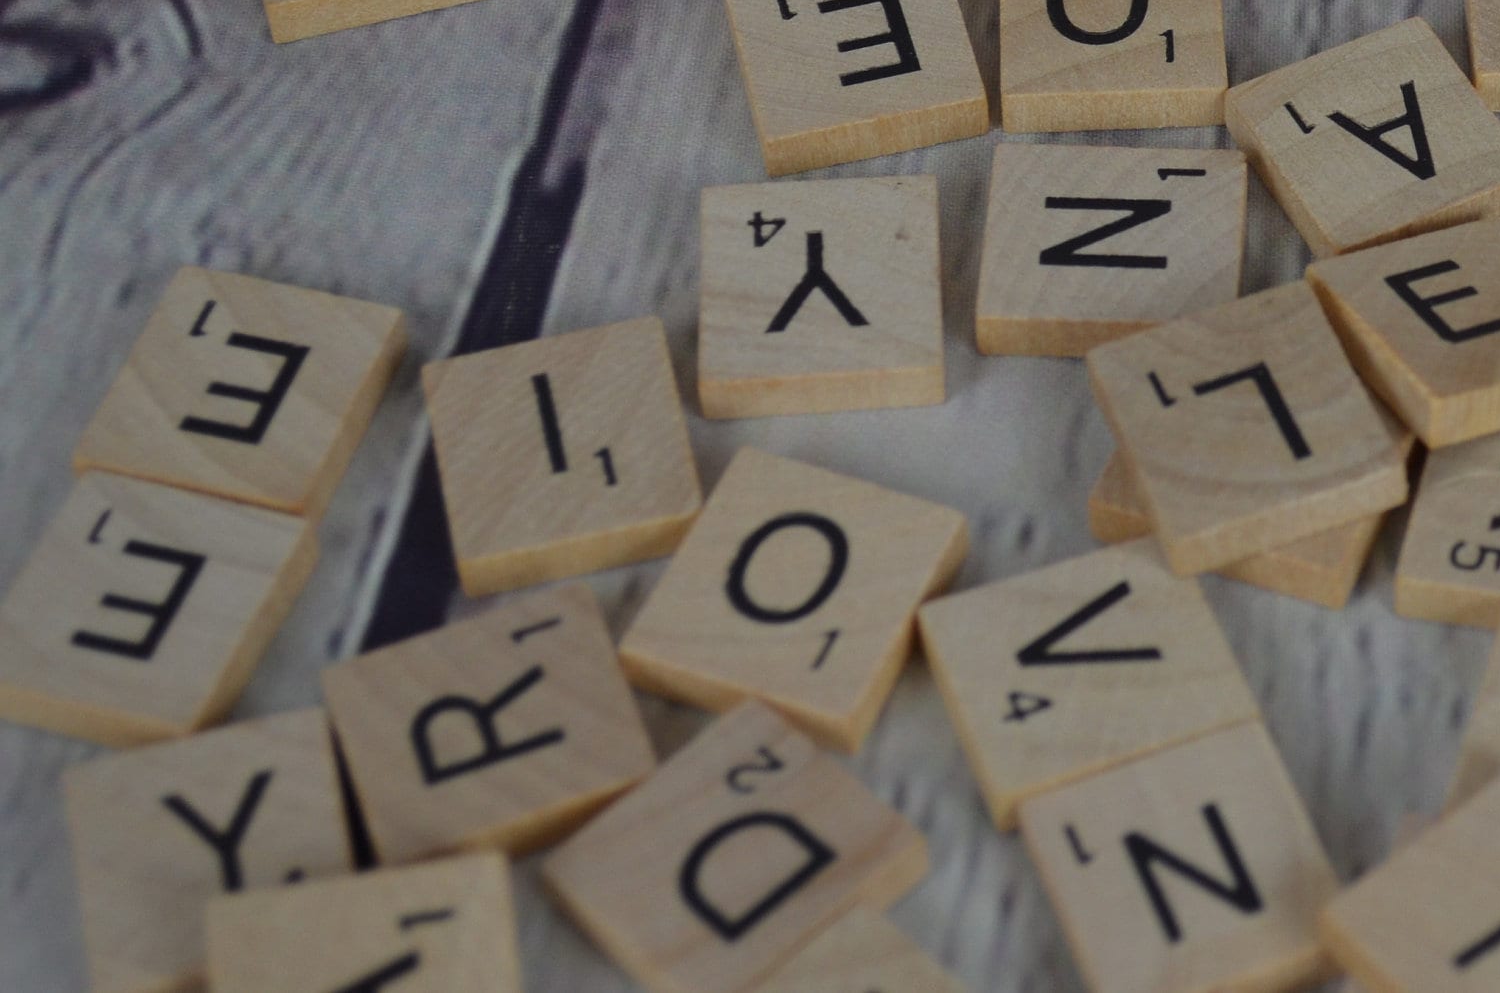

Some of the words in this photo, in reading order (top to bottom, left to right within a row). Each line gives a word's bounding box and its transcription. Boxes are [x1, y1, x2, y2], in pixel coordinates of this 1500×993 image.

[1327, 80, 1436, 180] A
[766, 231, 869, 333] Y
[1039, 197, 1171, 269] N
[179, 332, 311, 445] E
[1192, 361, 1311, 460] L
[71, 540, 207, 661] E
[724, 512, 849, 624] O
[1016, 581, 1162, 667] V
[410, 665, 565, 786] R
[162, 771, 272, 894] Y
[678, 811, 838, 943] D
[1123, 804, 1264, 943] N
